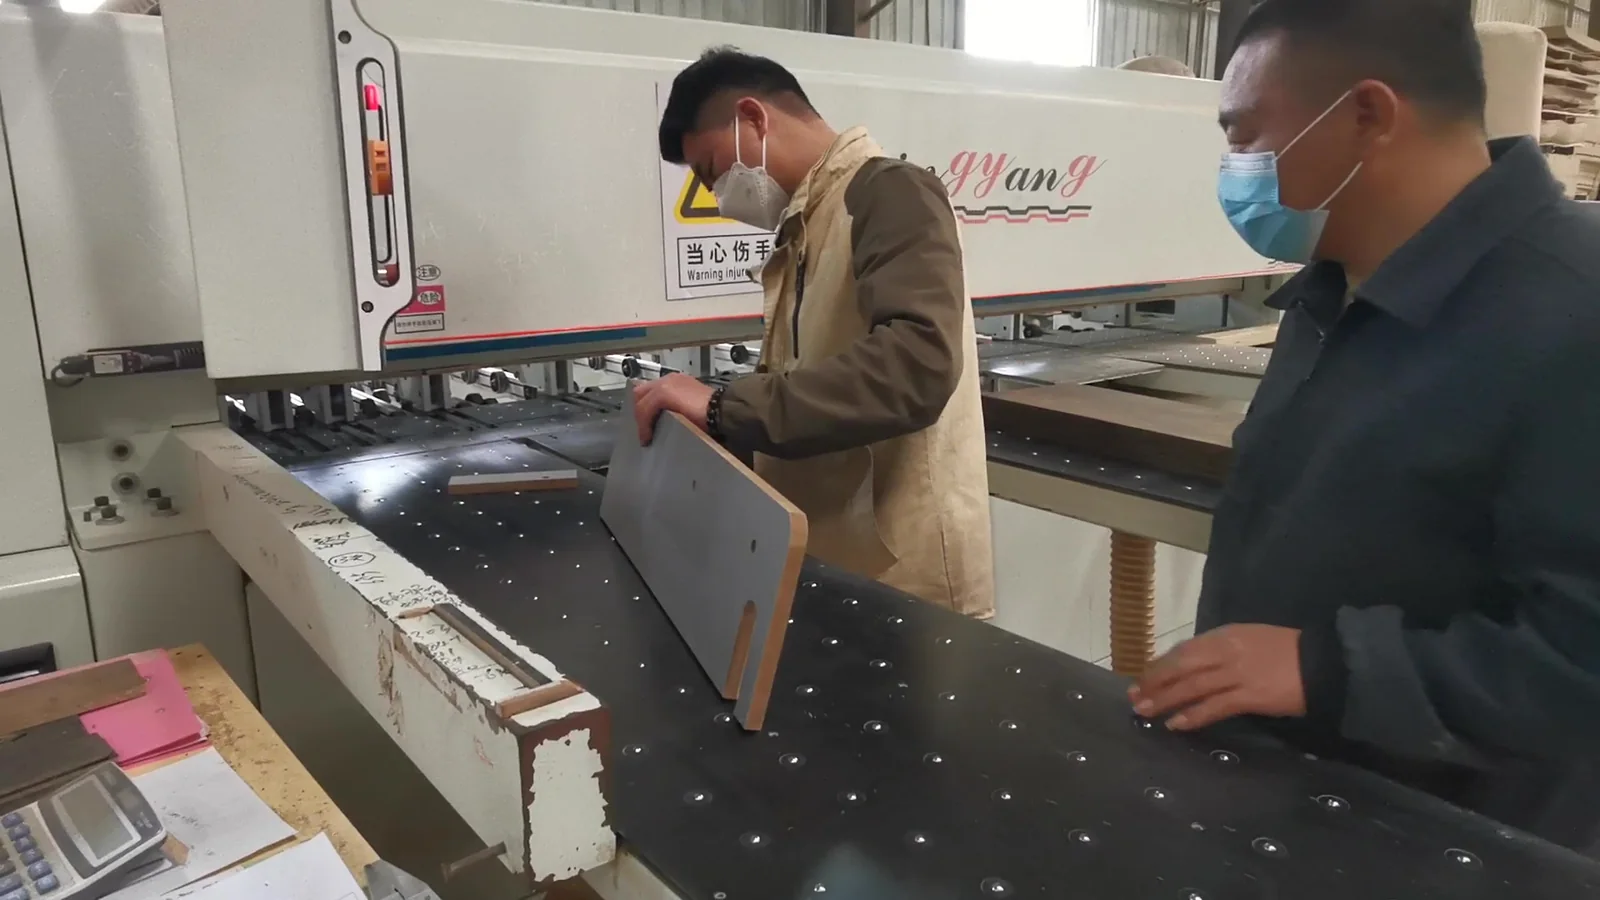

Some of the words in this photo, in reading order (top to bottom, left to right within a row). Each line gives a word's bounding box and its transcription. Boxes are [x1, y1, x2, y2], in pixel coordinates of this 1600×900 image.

[687, 239, 771, 265] 当心伤手
[687, 268, 723, 282] Warning
